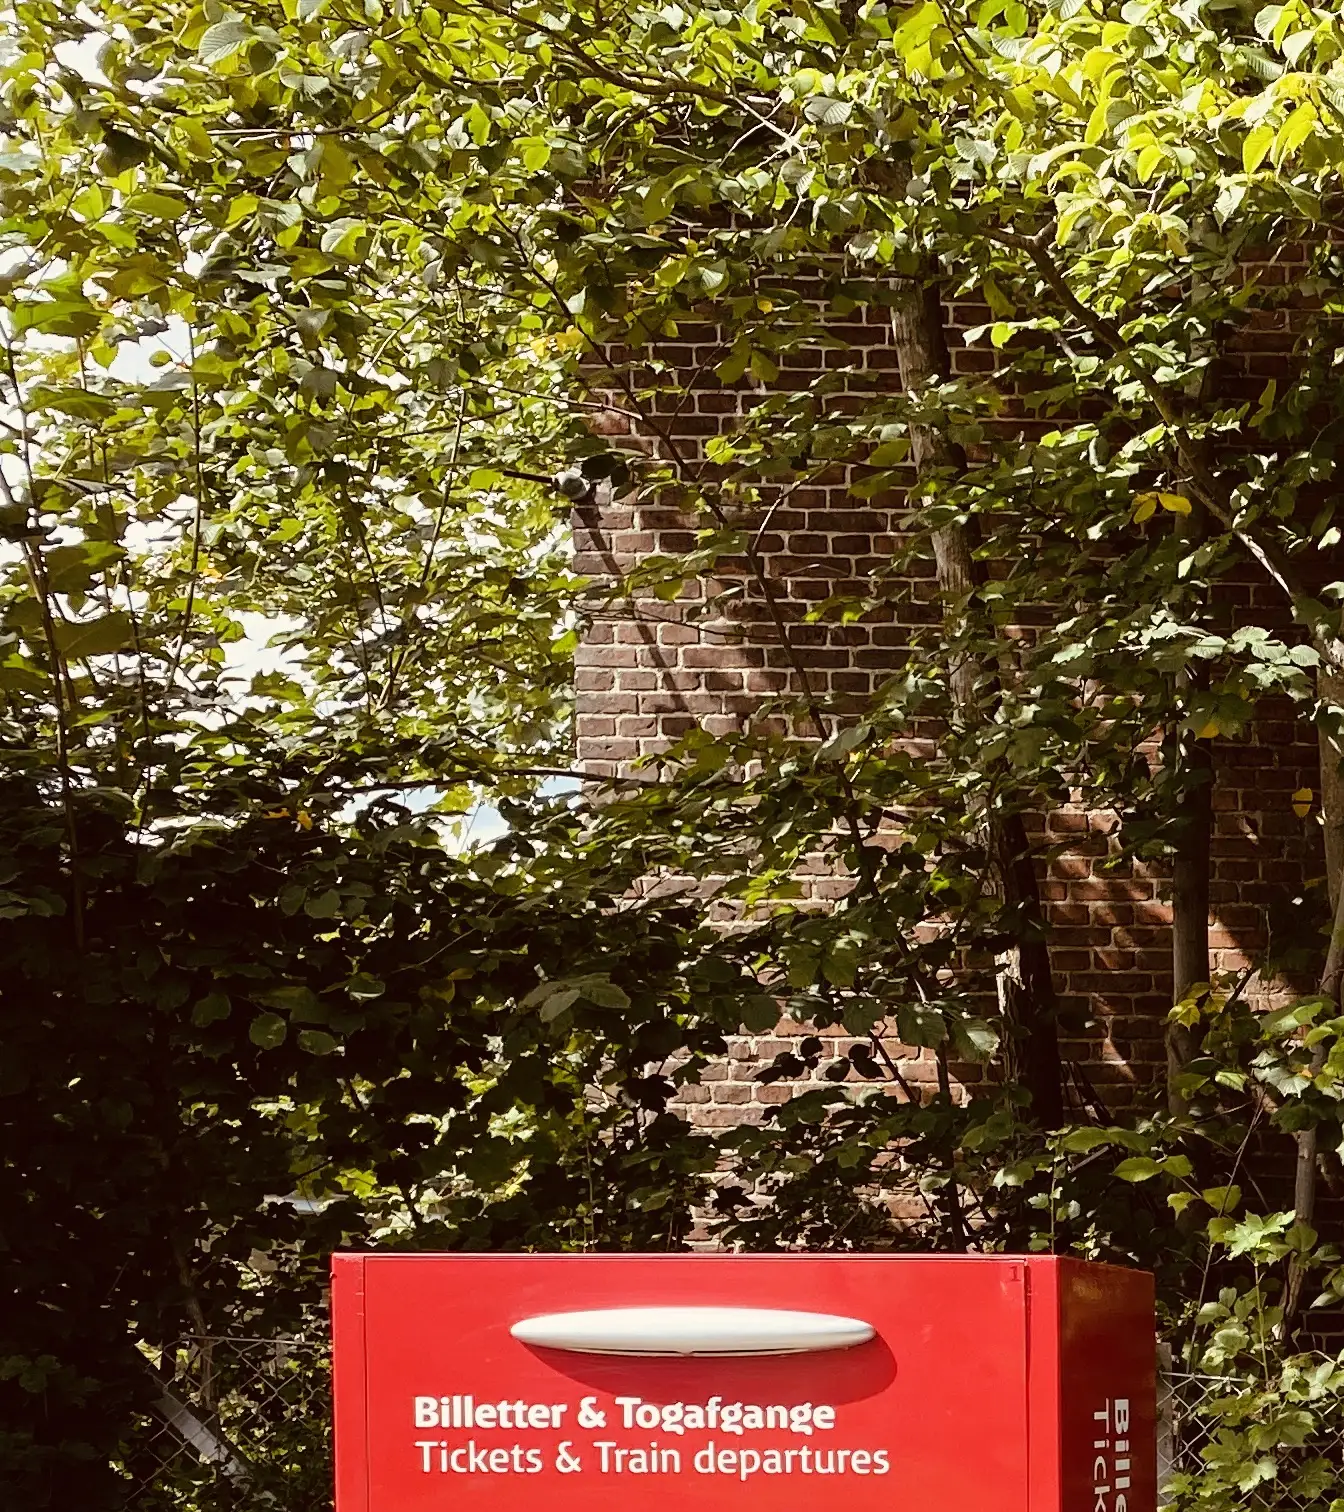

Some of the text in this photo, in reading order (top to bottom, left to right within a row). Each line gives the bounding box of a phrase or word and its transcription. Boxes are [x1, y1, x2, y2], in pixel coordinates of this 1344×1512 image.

[415, 1396, 835, 1435] Billetter & Togafgange
[415, 1441, 889, 1480] Tickets & Train departures
